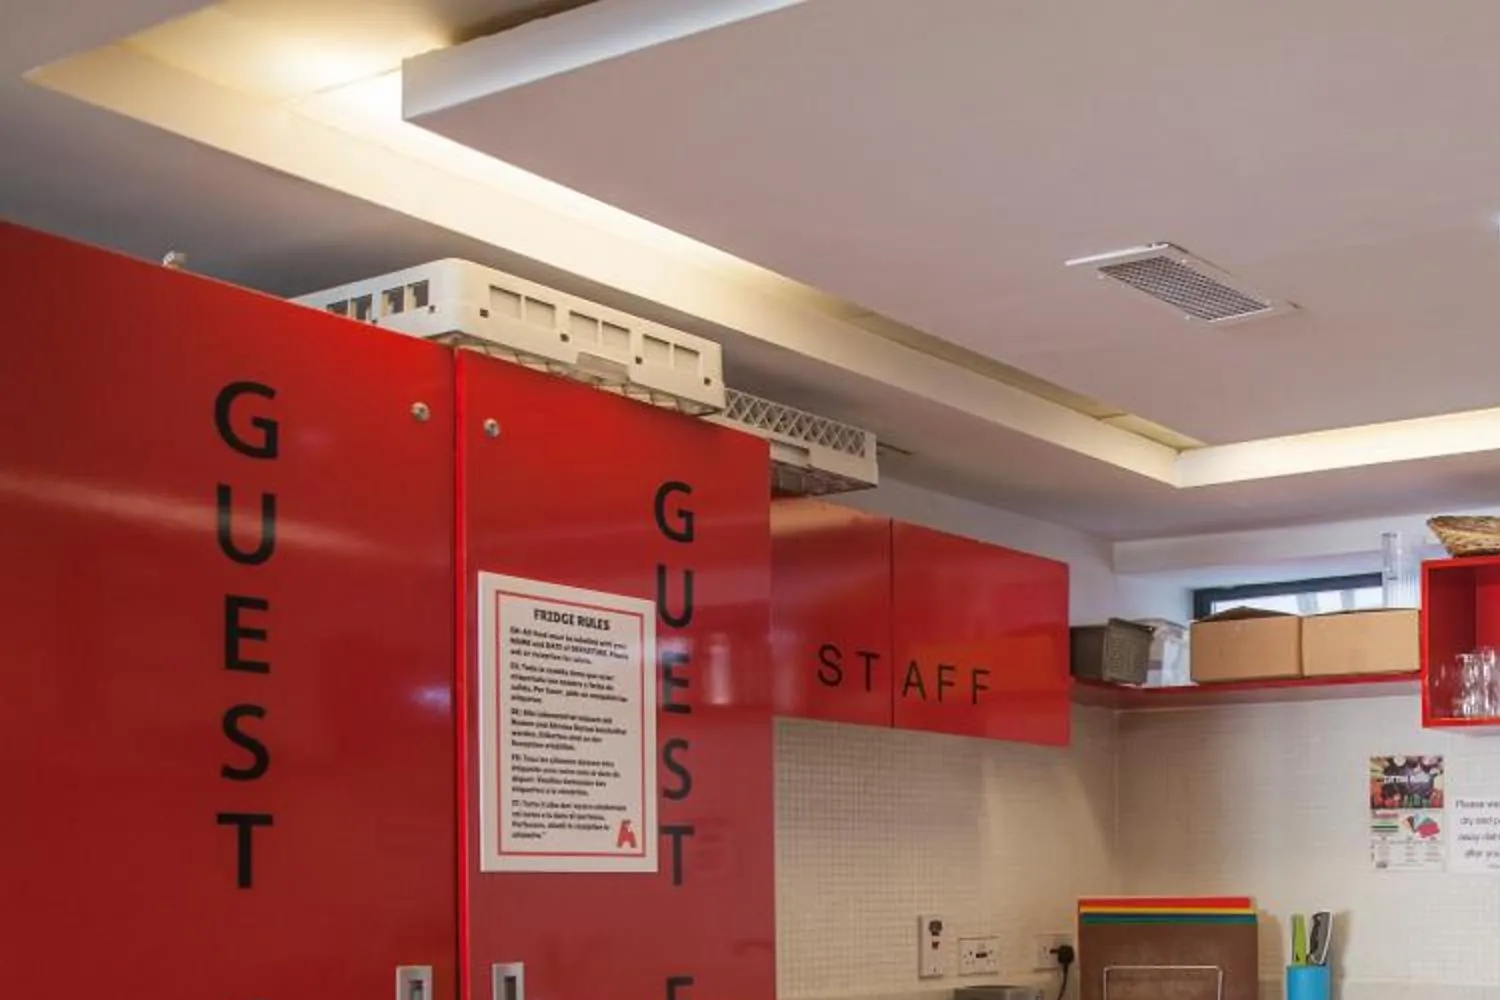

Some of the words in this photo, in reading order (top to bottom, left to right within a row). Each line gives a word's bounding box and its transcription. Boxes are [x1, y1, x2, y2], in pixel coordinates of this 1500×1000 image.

[214, 380, 279, 890] GUEST
[533, 608, 574, 626] FRIDGE
[576, 614, 611, 631] RULES
[653, 480, 695, 887] GUEST
[816, 643, 993, 706] STAFF
